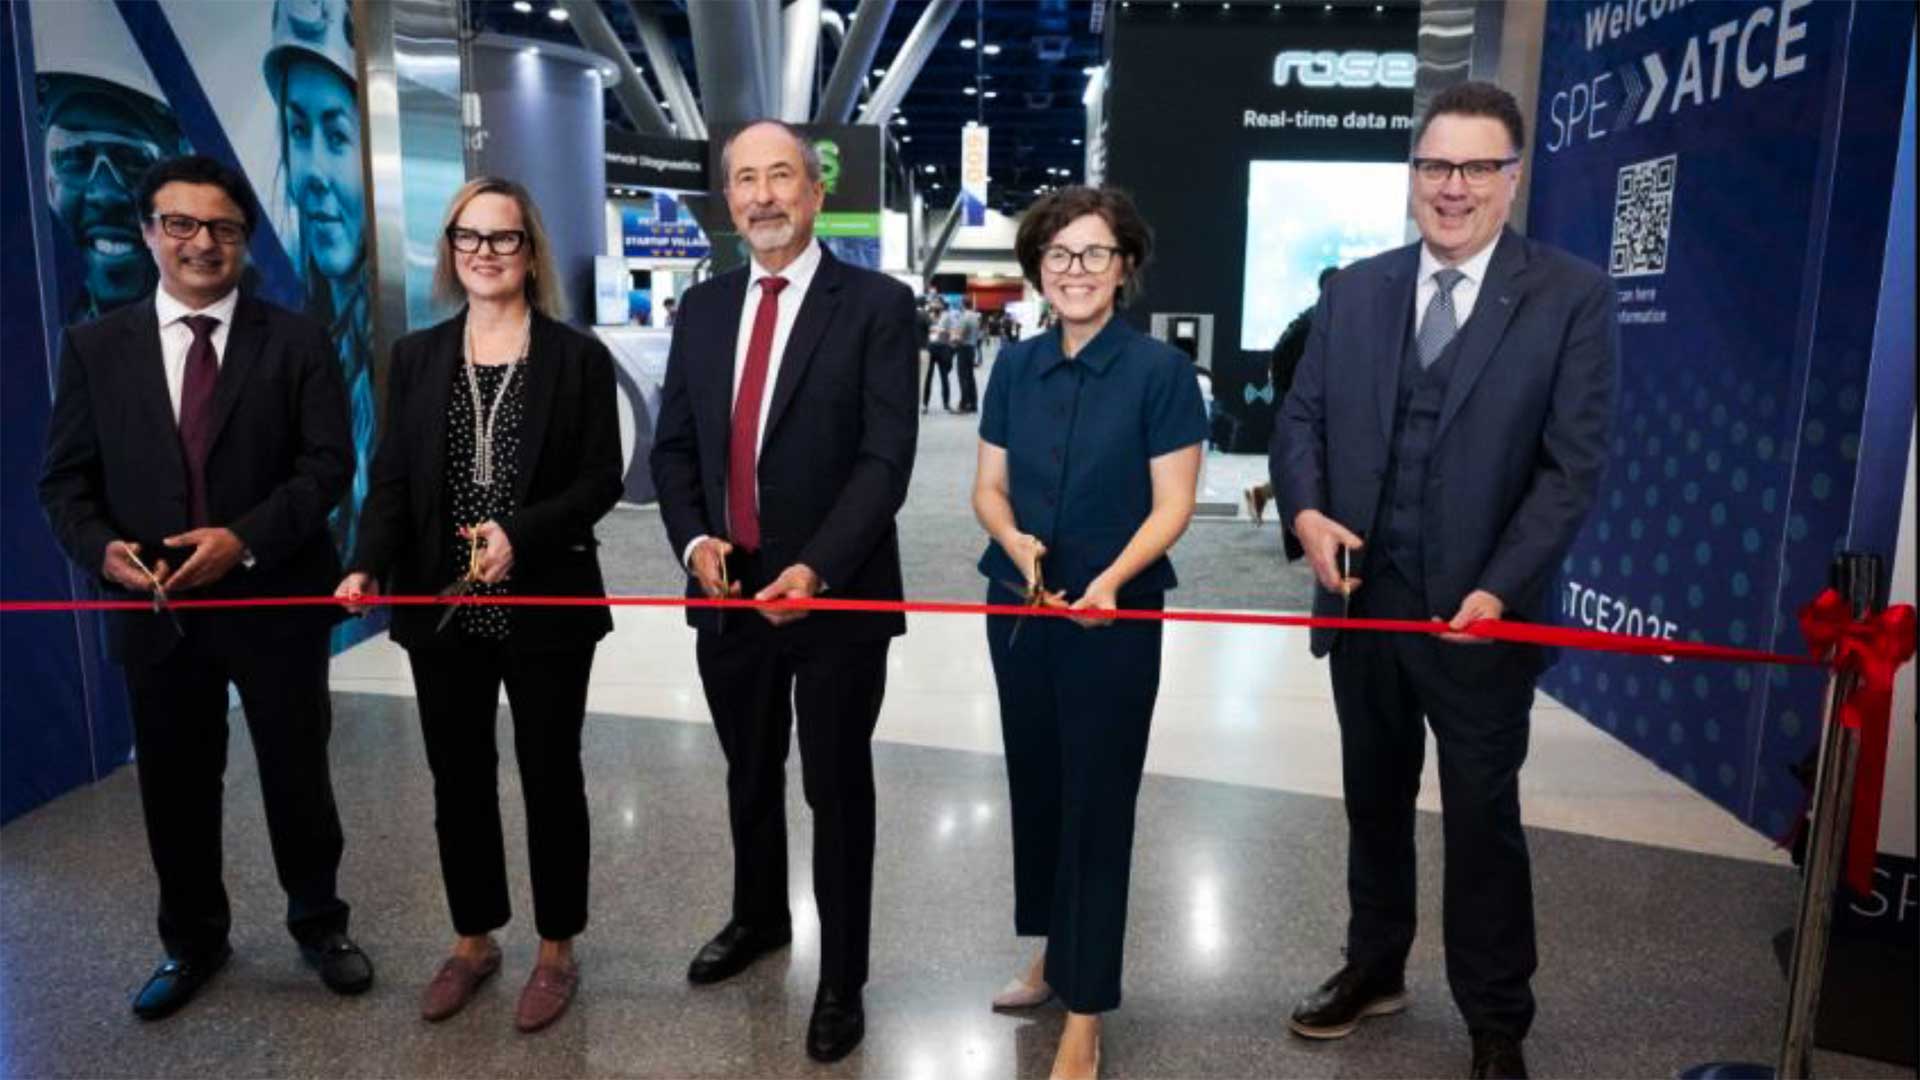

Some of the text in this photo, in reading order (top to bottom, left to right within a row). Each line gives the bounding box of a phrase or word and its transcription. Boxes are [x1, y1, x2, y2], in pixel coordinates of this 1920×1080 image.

[1547, 0, 1811, 152] SPE ATCE
[1243, 109, 1339, 129] Real-time
[1342, 111, 1387, 129] data
[638, 155, 702, 172] Diagnostics
[624, 236, 670, 247] STARTUP
[1561, 581, 1679, 663] TCE2025
